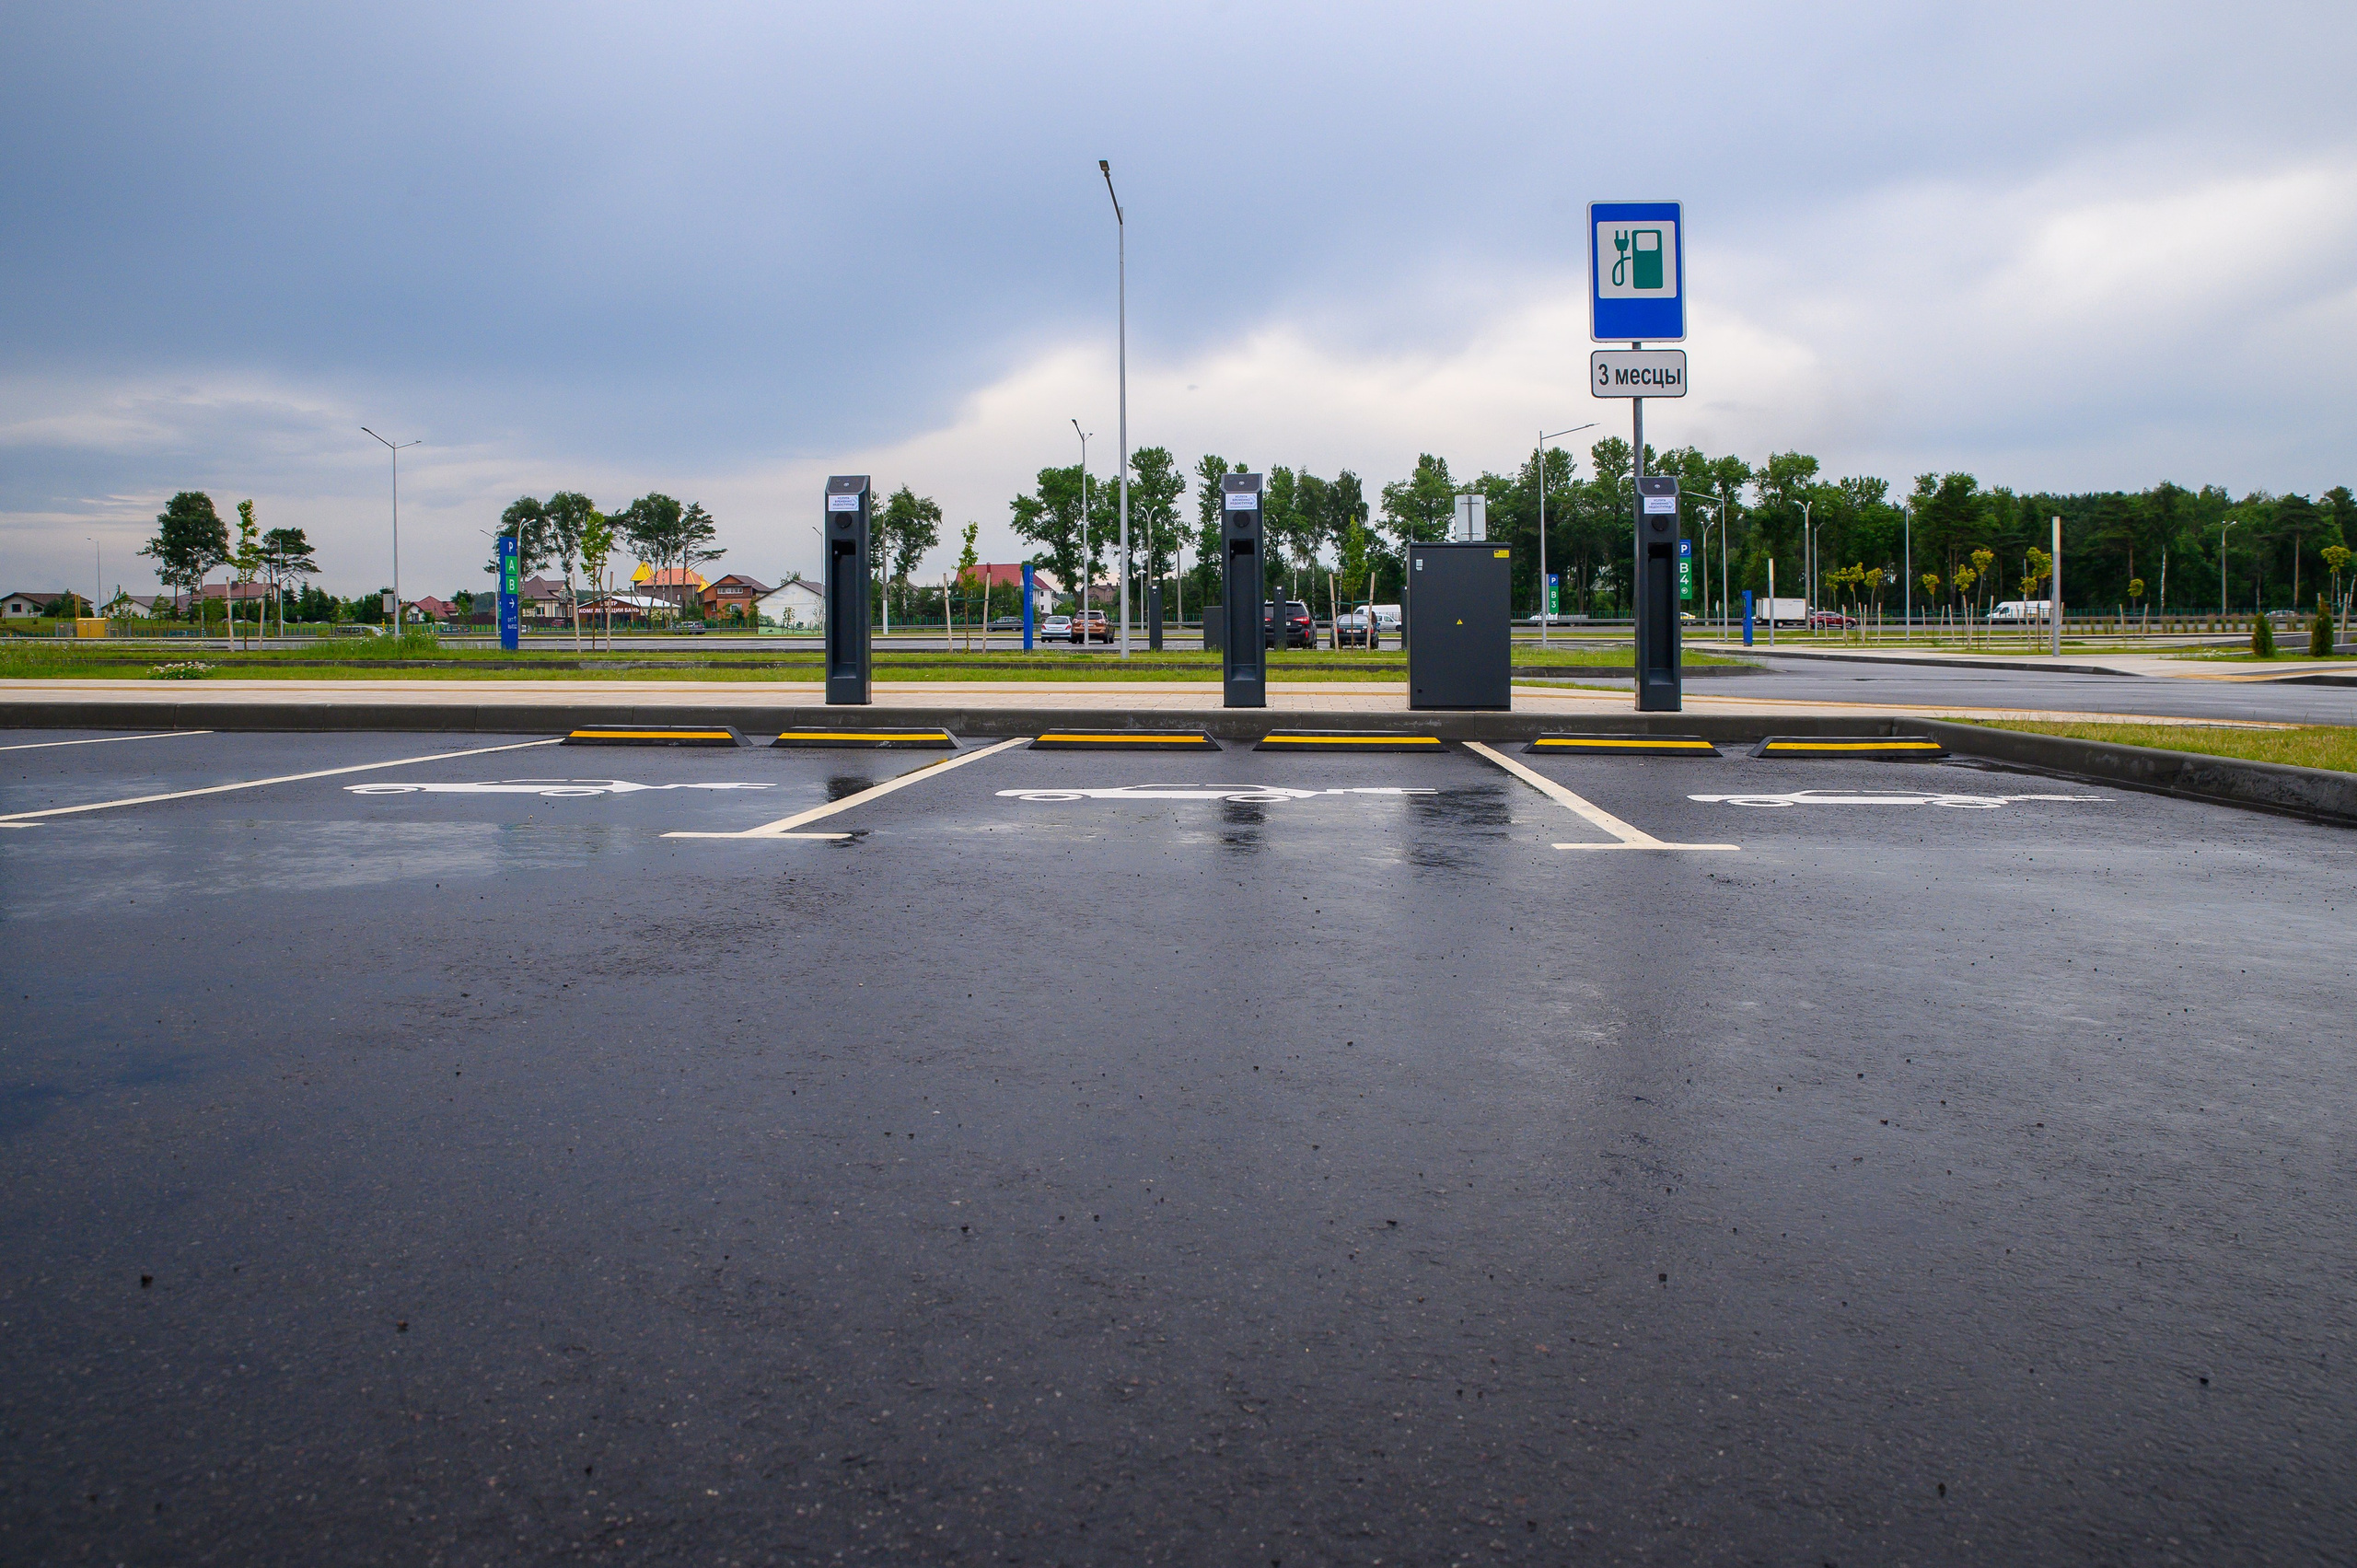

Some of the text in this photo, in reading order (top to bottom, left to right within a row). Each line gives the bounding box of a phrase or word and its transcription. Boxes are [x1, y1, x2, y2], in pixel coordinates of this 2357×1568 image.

[1597, 363, 1681, 389] 3 месцы
[508, 541, 514, 552] P
[1680, 544, 1688, 553] P
[509, 559, 515, 571] A
[1680, 563, 1689, 573] B
[509, 579, 515, 590] B
[1680, 574, 1689, 585] 4
